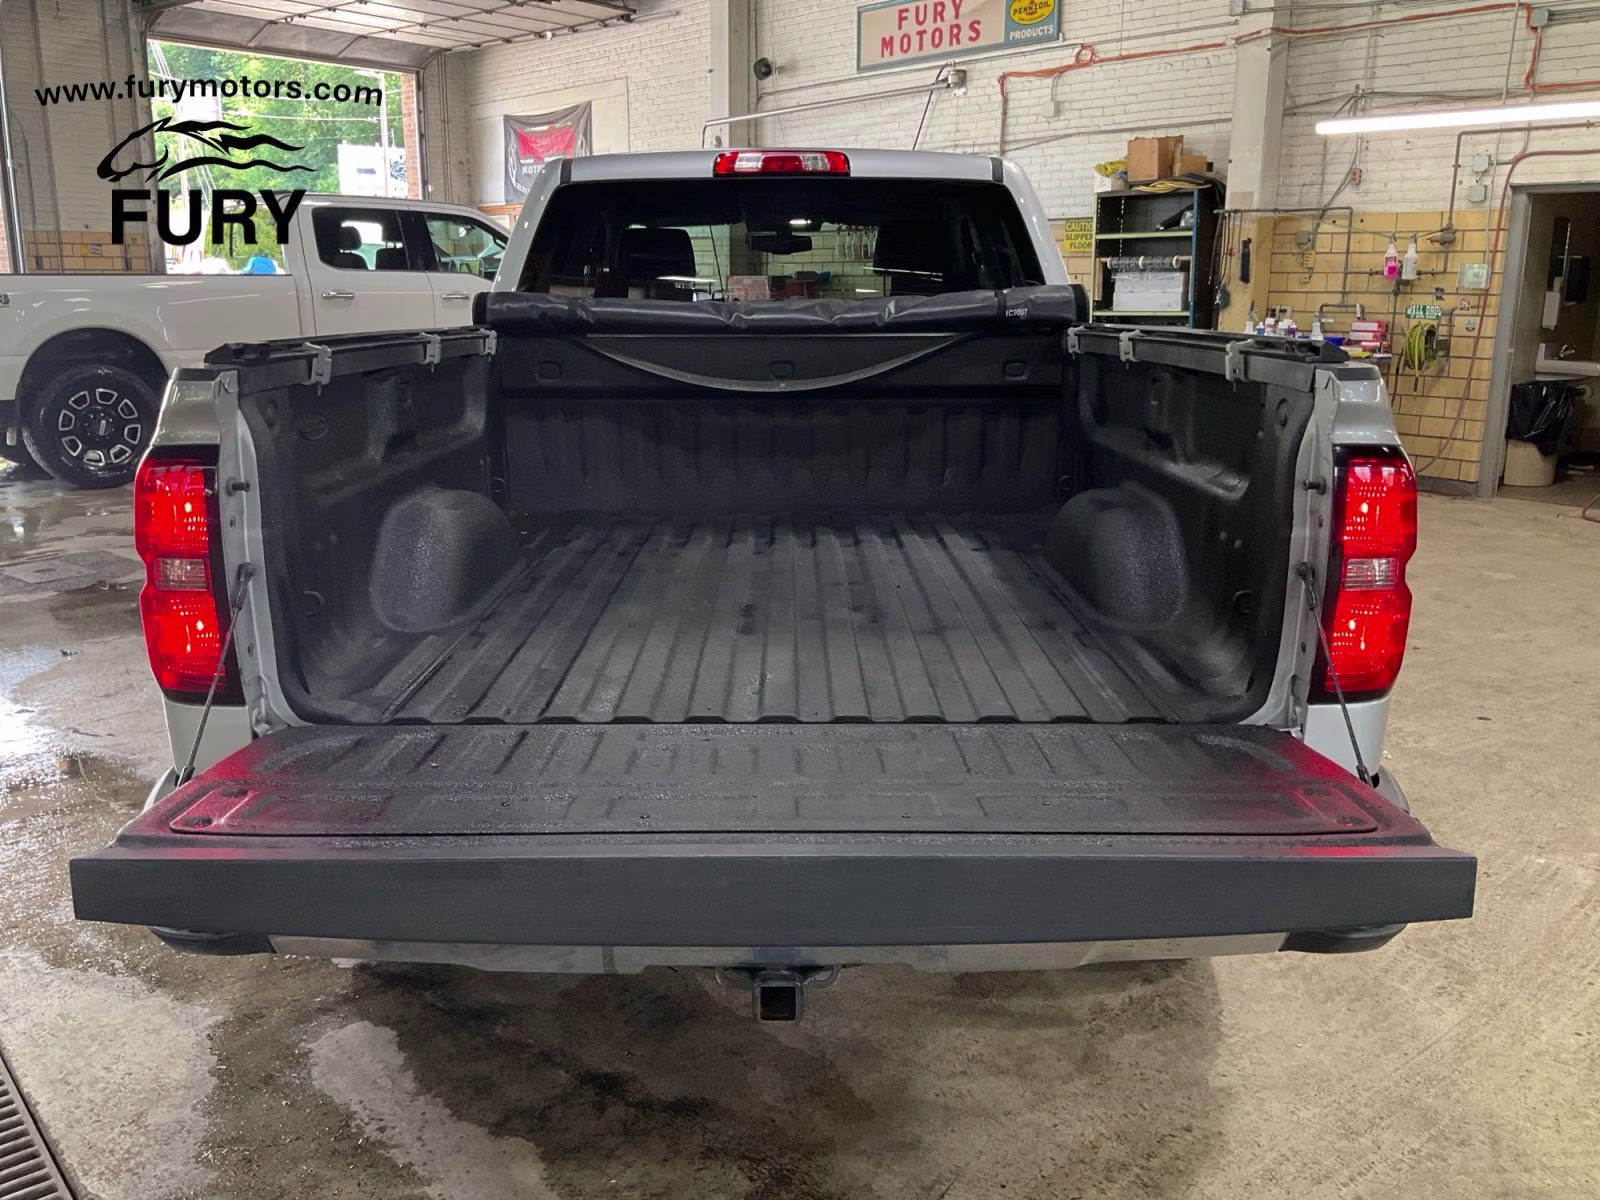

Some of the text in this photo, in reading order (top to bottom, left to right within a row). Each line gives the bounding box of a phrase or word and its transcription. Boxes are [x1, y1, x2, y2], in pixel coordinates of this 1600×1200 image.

[897, 0, 964, 30] FURY
[1013, 1, 1051, 16] PENNZOIL
[880, 20, 982, 58] MOTORS
[1009, 25, 1054, 40] PRODUCTS
[1066, 222, 1094, 231] CAUTIO
